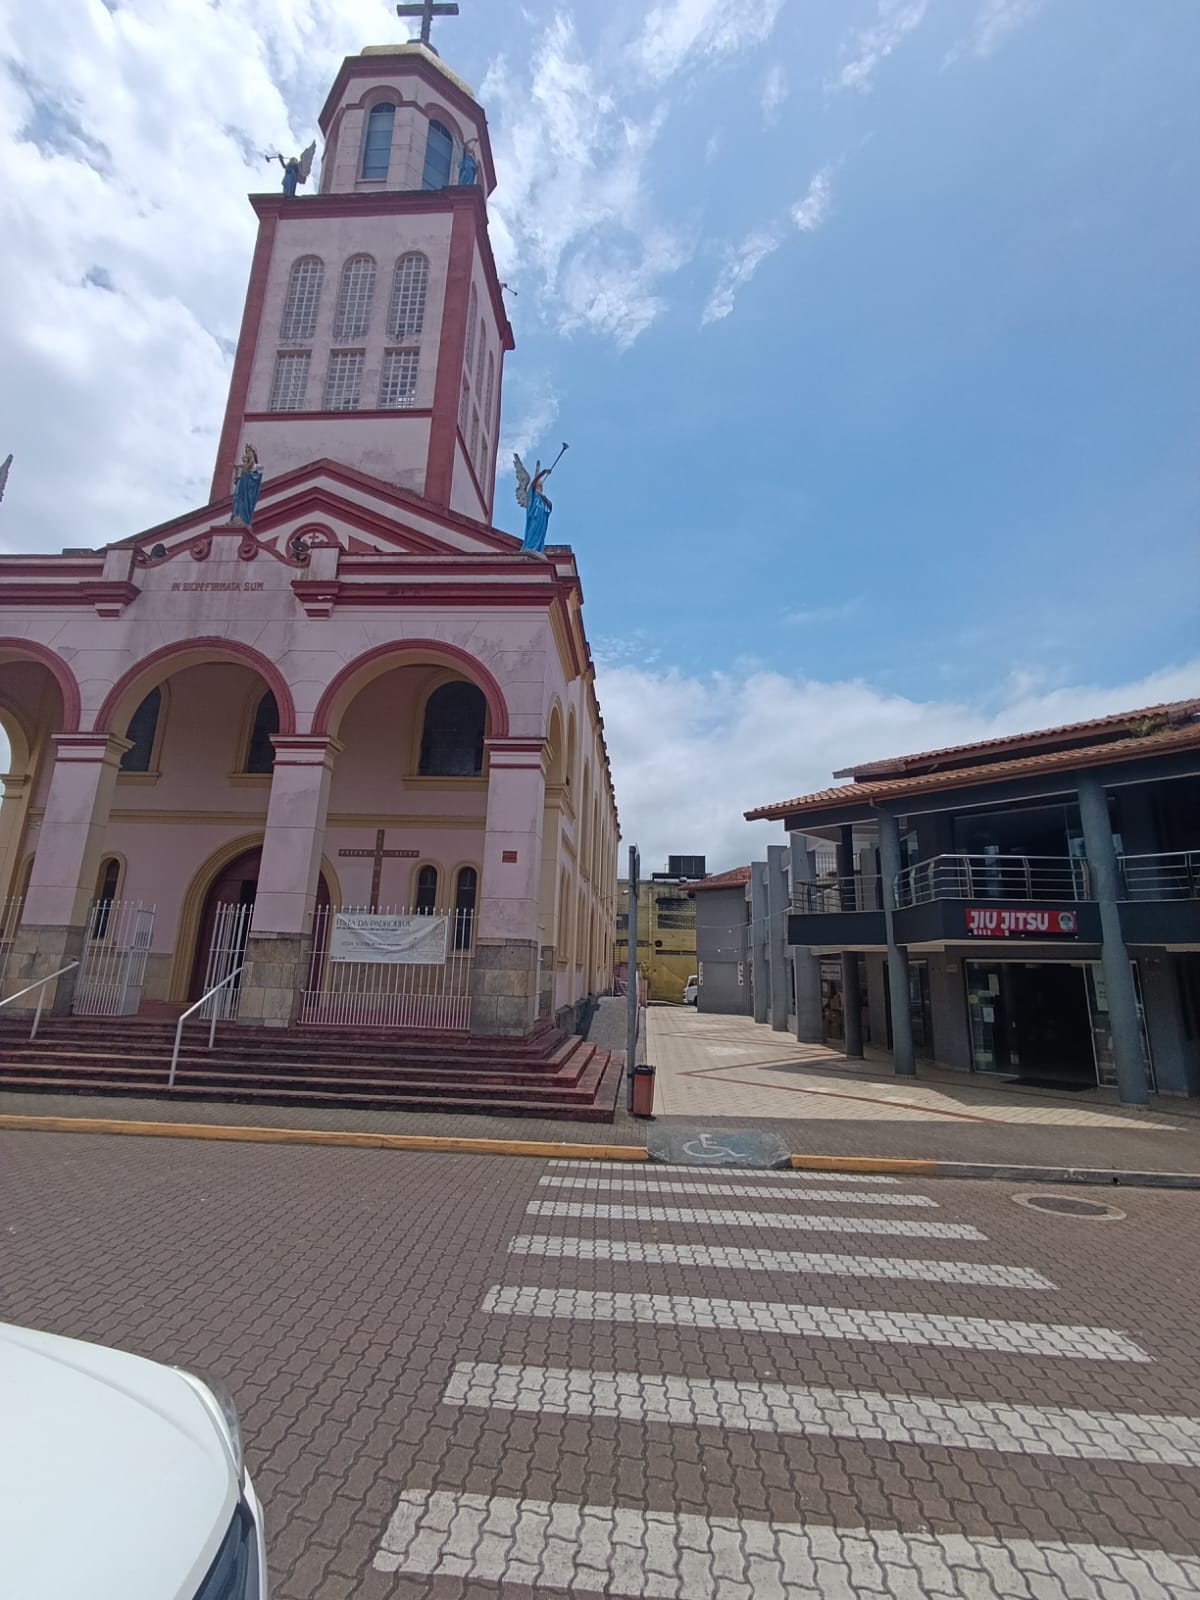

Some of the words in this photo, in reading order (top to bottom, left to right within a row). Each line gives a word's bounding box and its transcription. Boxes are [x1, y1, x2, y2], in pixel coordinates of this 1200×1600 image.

[171, 582, 181, 592] IN
[204, 582, 241, 592] FIRMATA
[243, 582, 264, 592] SUM
[969, 911, 998, 929] JIU
[1000, 912, 1049, 931] JITSU
